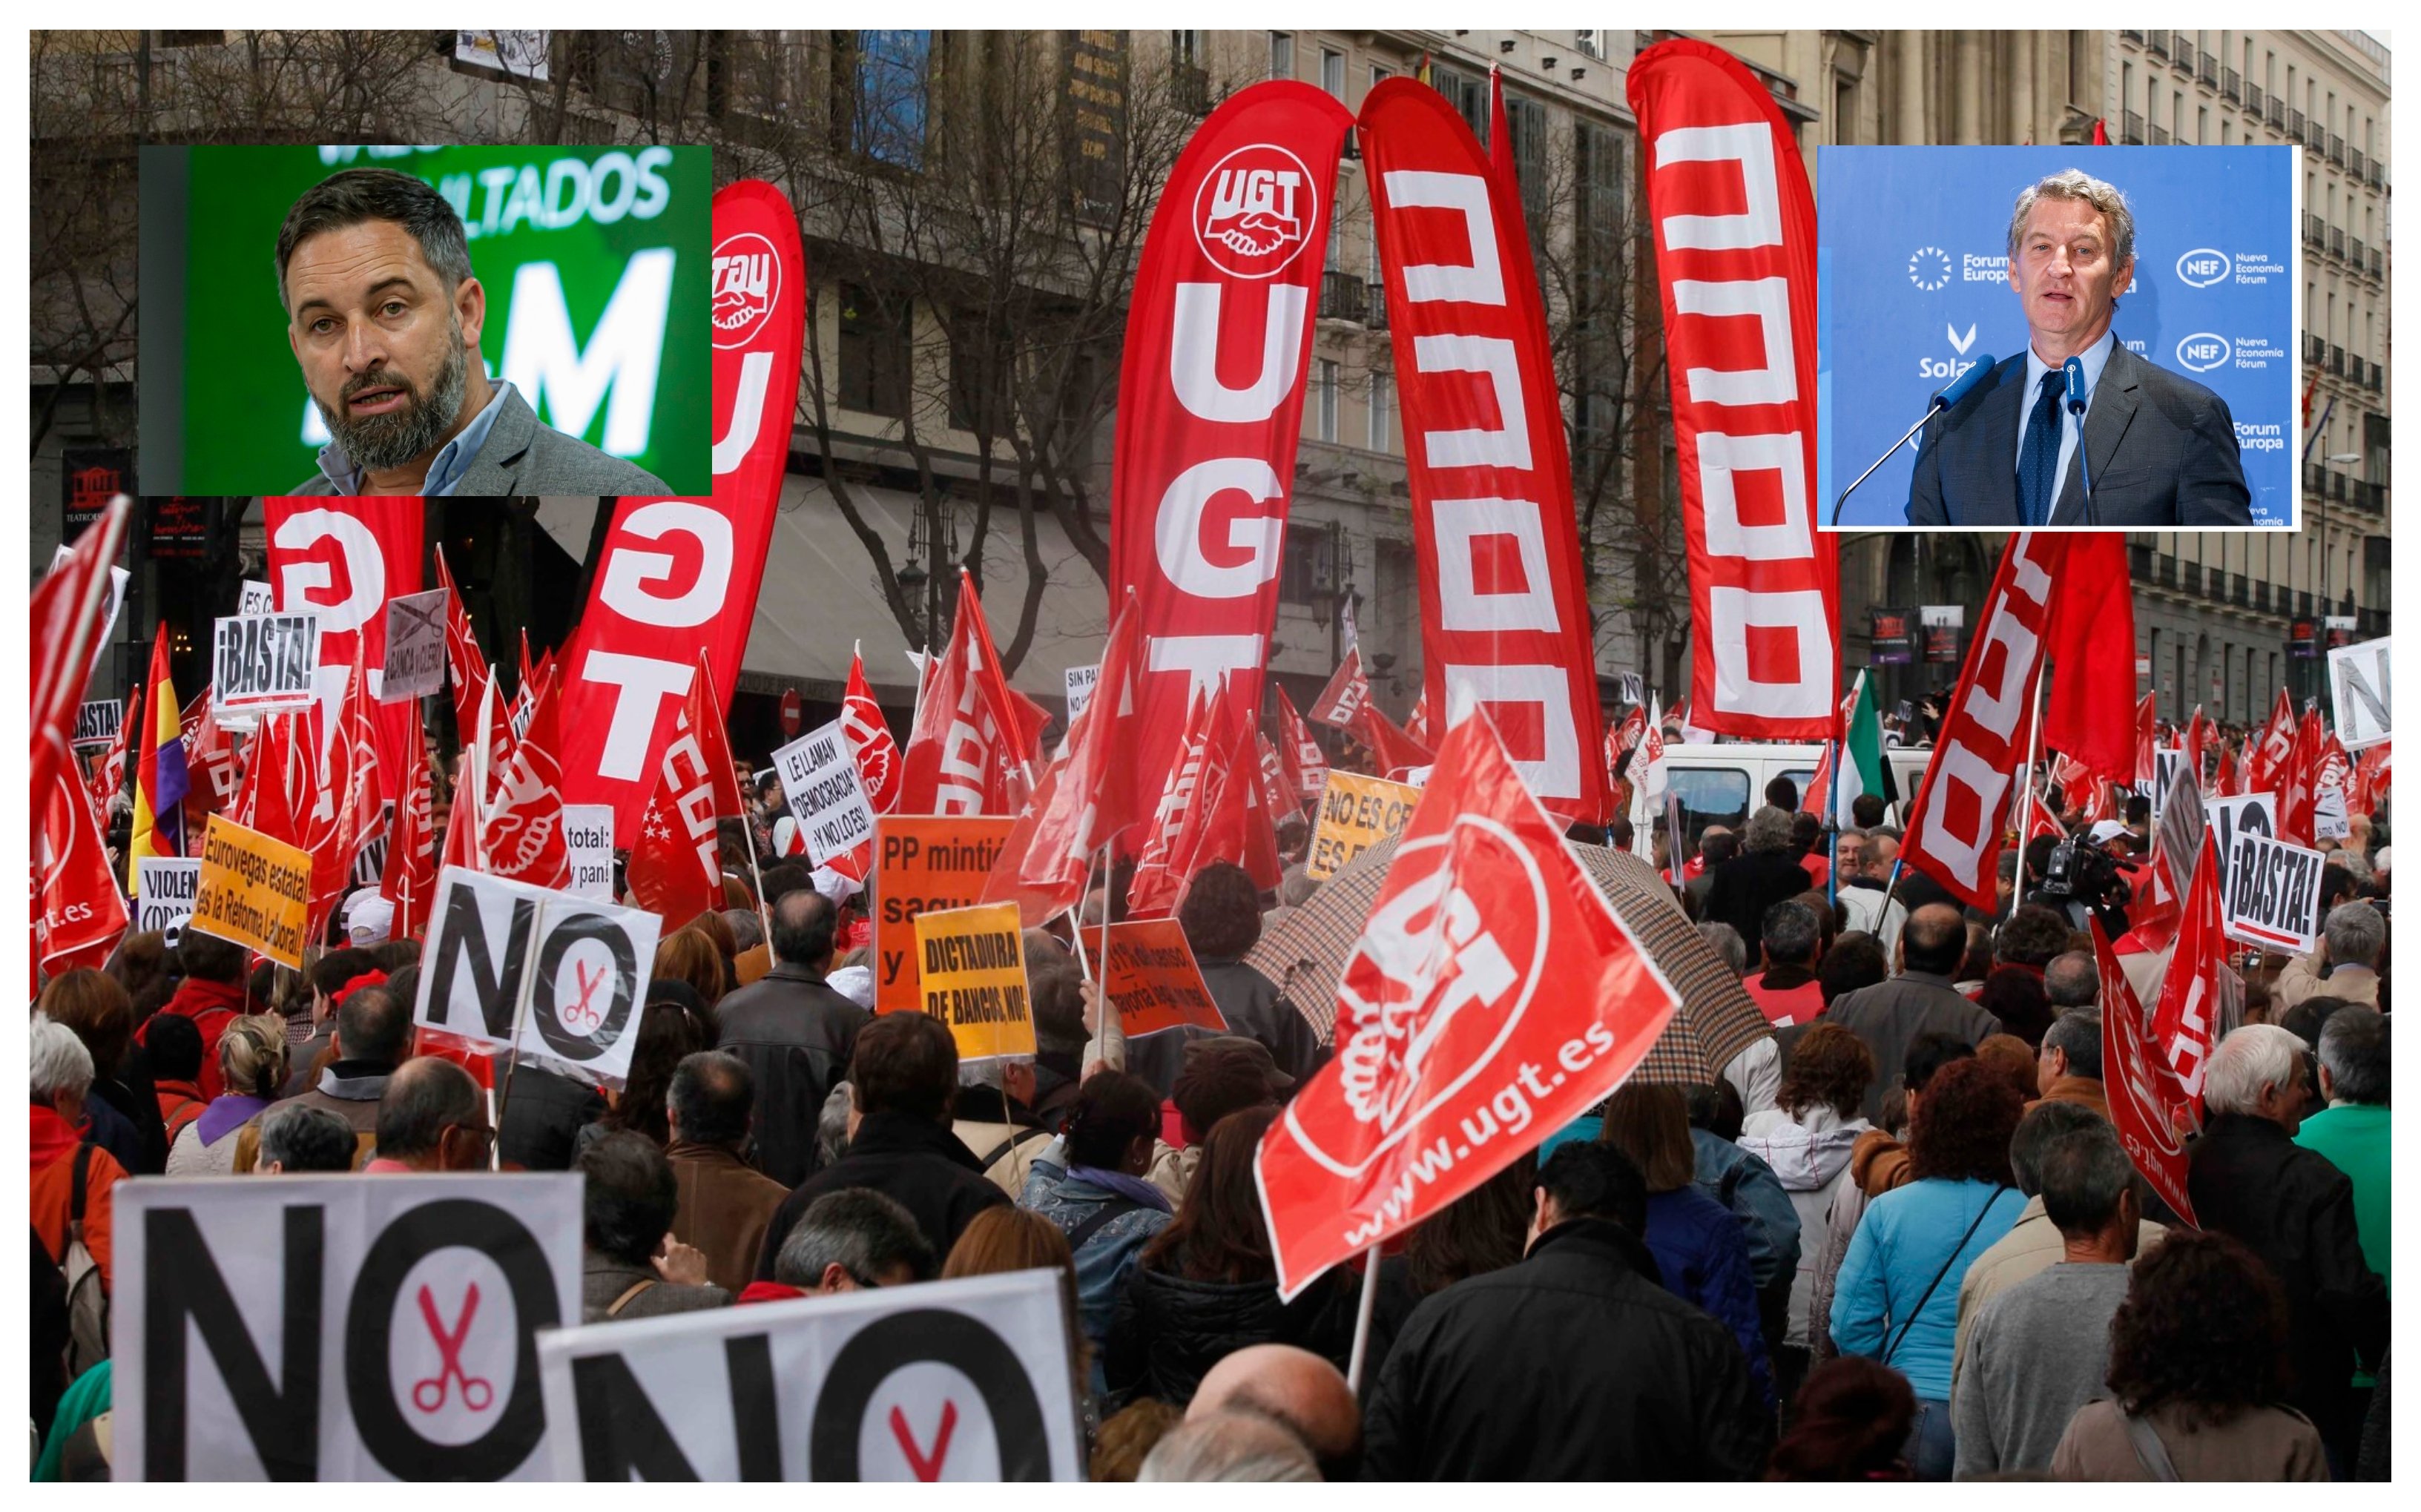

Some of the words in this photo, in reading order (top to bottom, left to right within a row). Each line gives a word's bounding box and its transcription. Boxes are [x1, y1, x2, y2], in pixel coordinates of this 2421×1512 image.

[439, 146, 673, 240] LTADOS
[1211, 170, 1301, 221] UGT
[2187, 260, 2219, 275] NEF
[2236, 253, 2267, 262] Nueva
[2236, 263, 2284, 273] Economía
[2236, 274, 2267, 284] Fórum
[2187, 344, 2219, 359] NEF
[2236, 337, 2267, 346] Nueva
[2236, 348, 2284, 357] Economía
[1919, 357, 1970, 378] Sola
[2236, 359, 2267, 369] Fórum
[1148, 283, 1308, 723] UGT
[2253, 516, 2284, 526] nomía
[244, 591, 260, 614] ES
[262, 594, 273, 614] C
[217, 616, 316, 703] ¡BASTA!
[1068, 671, 1083, 687] SIN
[1085, 669, 1099, 685] PA
[1070, 696, 1081, 711] NO
[2336, 648, 2391, 742] N
[75, 702, 119, 739] ASTA!
[786, 754, 803, 782] LE
[800, 736, 838, 776] LLAMAN
[791, 767, 857, 820] "DEMOCRACIA"
[1323, 790, 1355, 825] NO
[1355, 794, 1383, 831] ES
[568, 826, 610, 848] total:
[822, 818, 841, 848] NO
[836, 813, 854, 840] LO
[849, 805, 870, 835] ES!
[205, 826, 268, 888] Eurovegas
[269, 862, 310, 905] estatal
[883, 836, 920, 871] PP
[1314, 837, 1345, 874] ES
[145, 870, 199, 899] VIOLEN
[580, 862, 610, 889] pan!
[2227, 838, 2319, 936] ¡BASTA!
[197, 888, 211, 915] es
[211, 885, 223, 920] la
[223, 889, 263, 940] Reforma
[424, 882, 639, 1060] NO
[883, 950, 903, 986] y
[924, 931, 1020, 975] DICTADURA
[927, 990, 949, 1028] DE
[953, 986, 1008, 1027] BANCOS,
[1005, 984, 1027, 1023] NO!
[1344, 1020, 1615, 1247] www.ugt.es
[143, 1198, 561, 1483] NO
[570, 1308, 1050, 1483] NO
